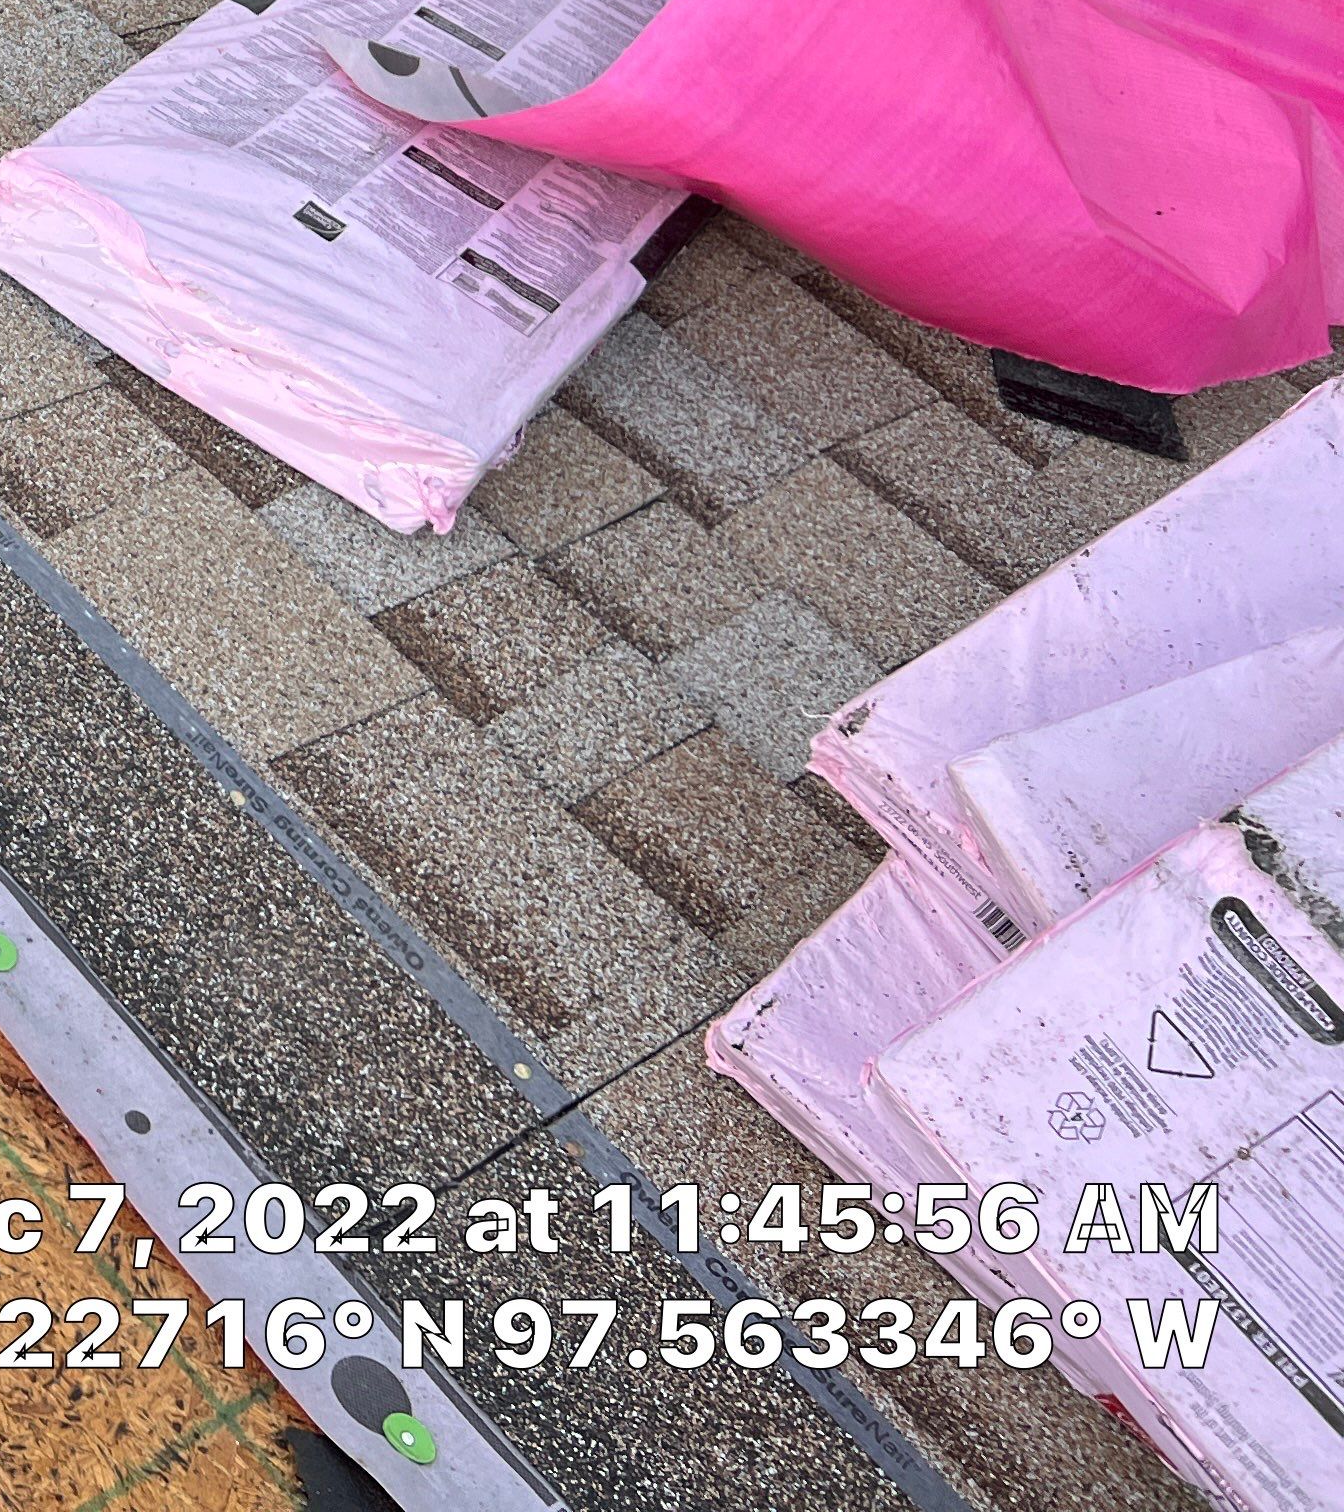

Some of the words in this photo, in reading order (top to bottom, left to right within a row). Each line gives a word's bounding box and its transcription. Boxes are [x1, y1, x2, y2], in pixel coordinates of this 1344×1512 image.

[188, 728, 270, 814] SureNail
[273, 814, 353, 897] Corning
[931, 846, 983, 902] Southwest
[1224, 912, 1270, 963] COUNTY
